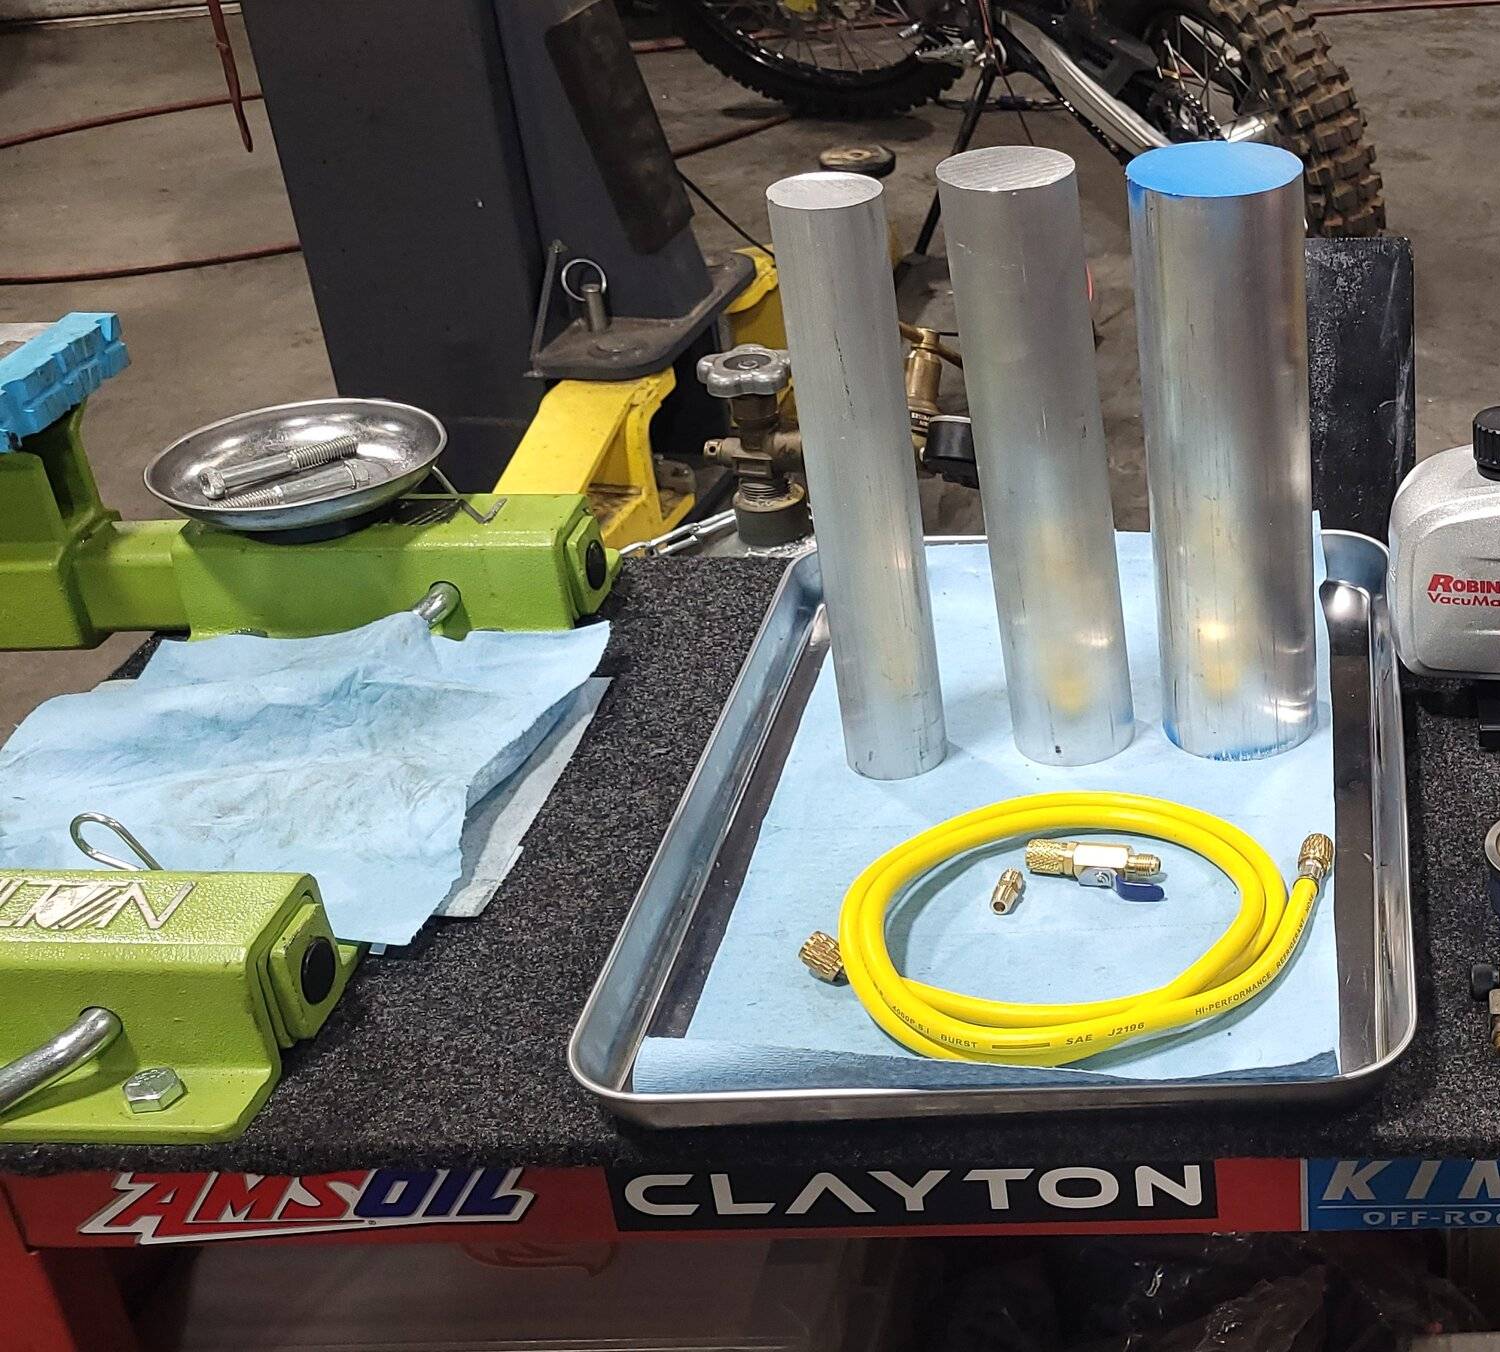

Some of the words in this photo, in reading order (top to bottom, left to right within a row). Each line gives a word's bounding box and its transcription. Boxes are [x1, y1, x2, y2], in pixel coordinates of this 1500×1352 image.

[940, 1032, 977, 1049] BURST
[1065, 1034, 1093, 1046] SAE
[1107, 1021, 1145, 1037] J2196
[1195, 971, 1272, 1016] HI-PERFORMANCE
[1276, 919, 1306, 969] REFRIGERANT
[80, 1167, 534, 1245] AMSOIL
[624, 1164, 1202, 1216] CLAYTON
